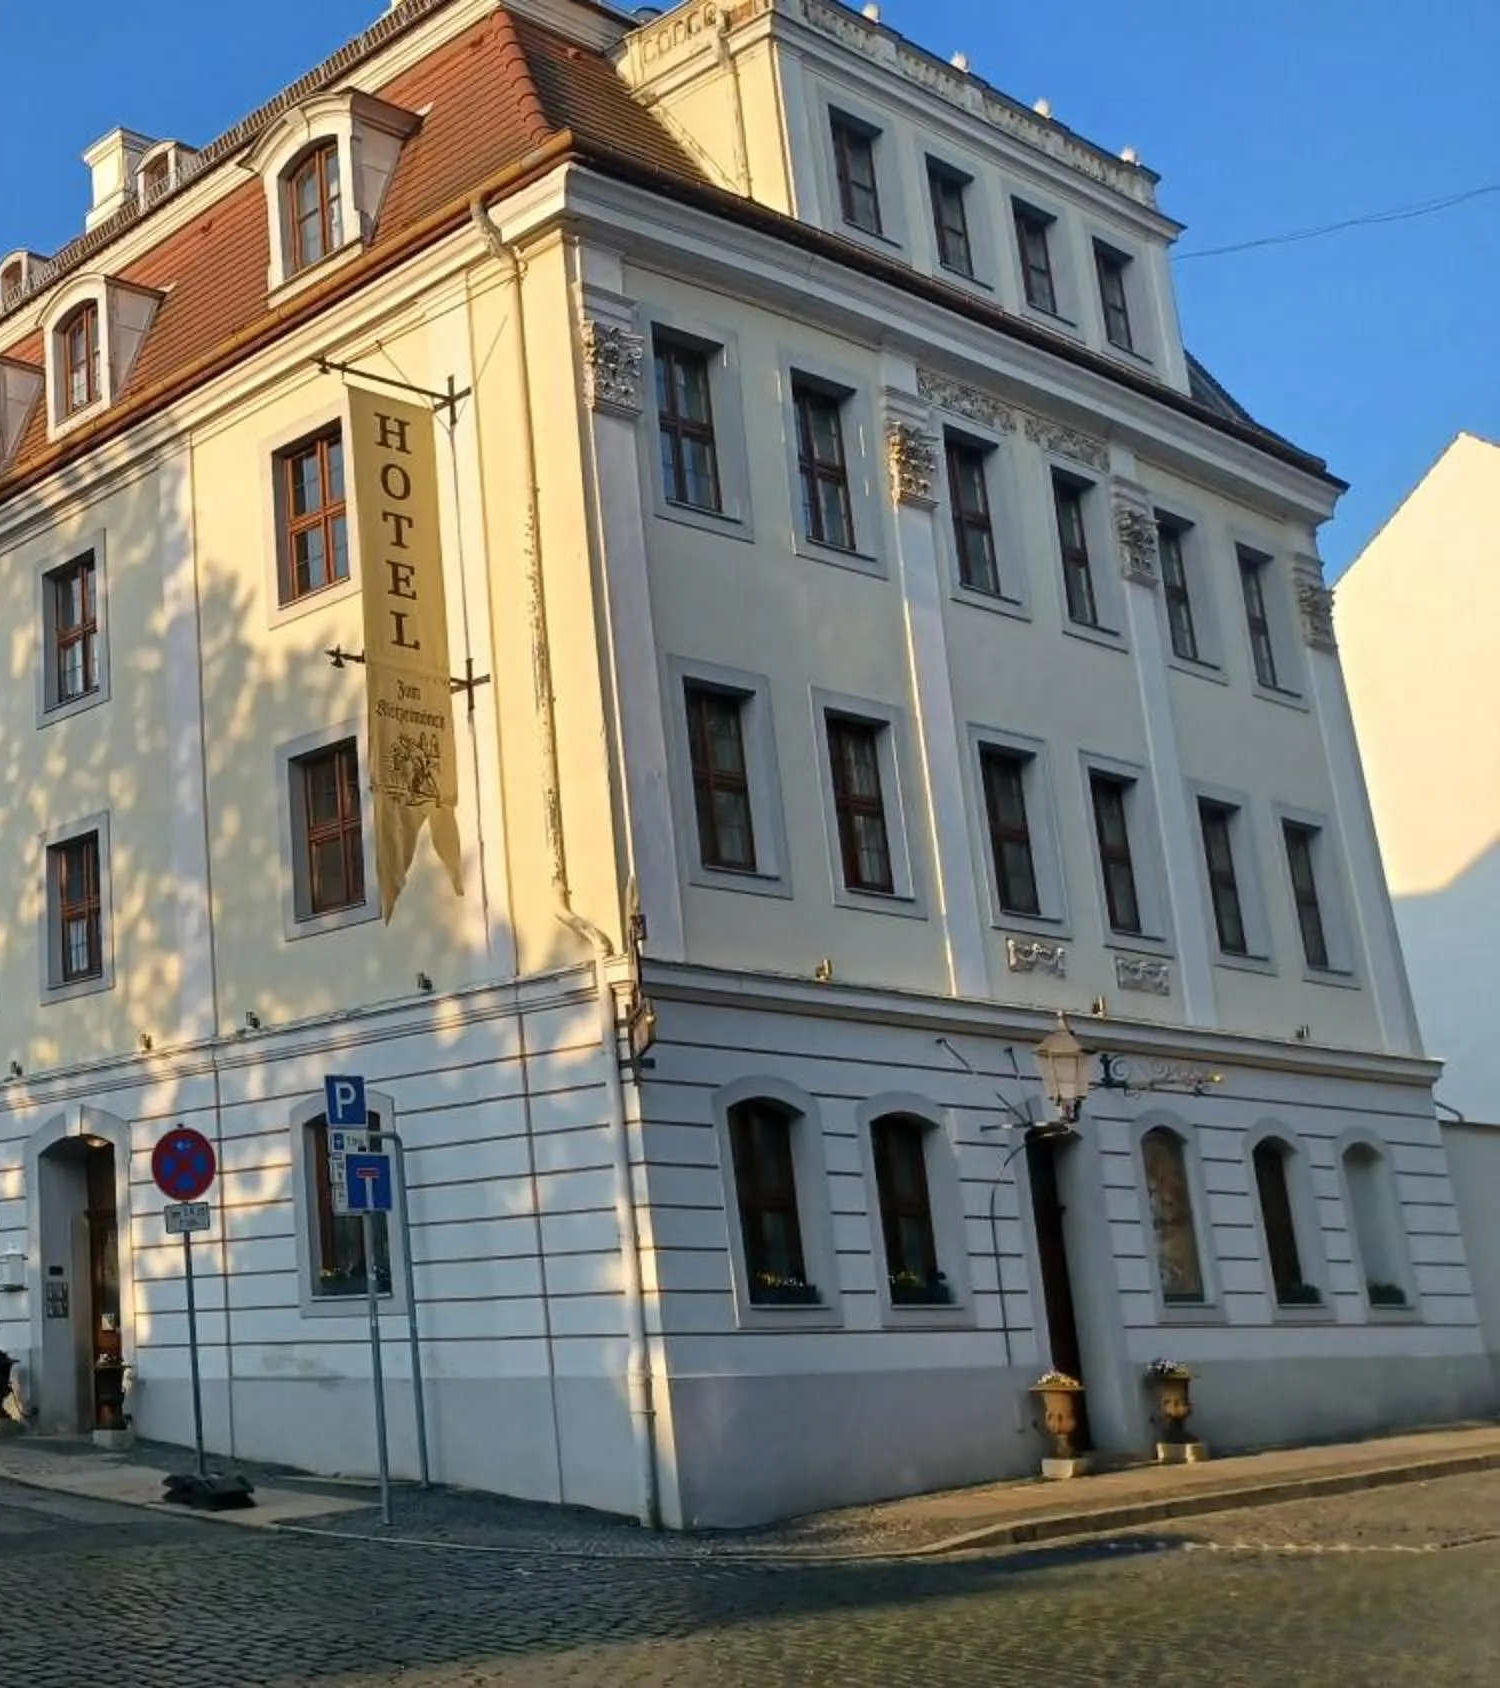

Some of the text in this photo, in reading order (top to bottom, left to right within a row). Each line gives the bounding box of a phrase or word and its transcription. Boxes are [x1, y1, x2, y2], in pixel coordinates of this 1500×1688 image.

[374, 412, 420, 651] HOTEL
[396, 679, 421, 701] Zum
[334, 1081, 356, 1120] P
